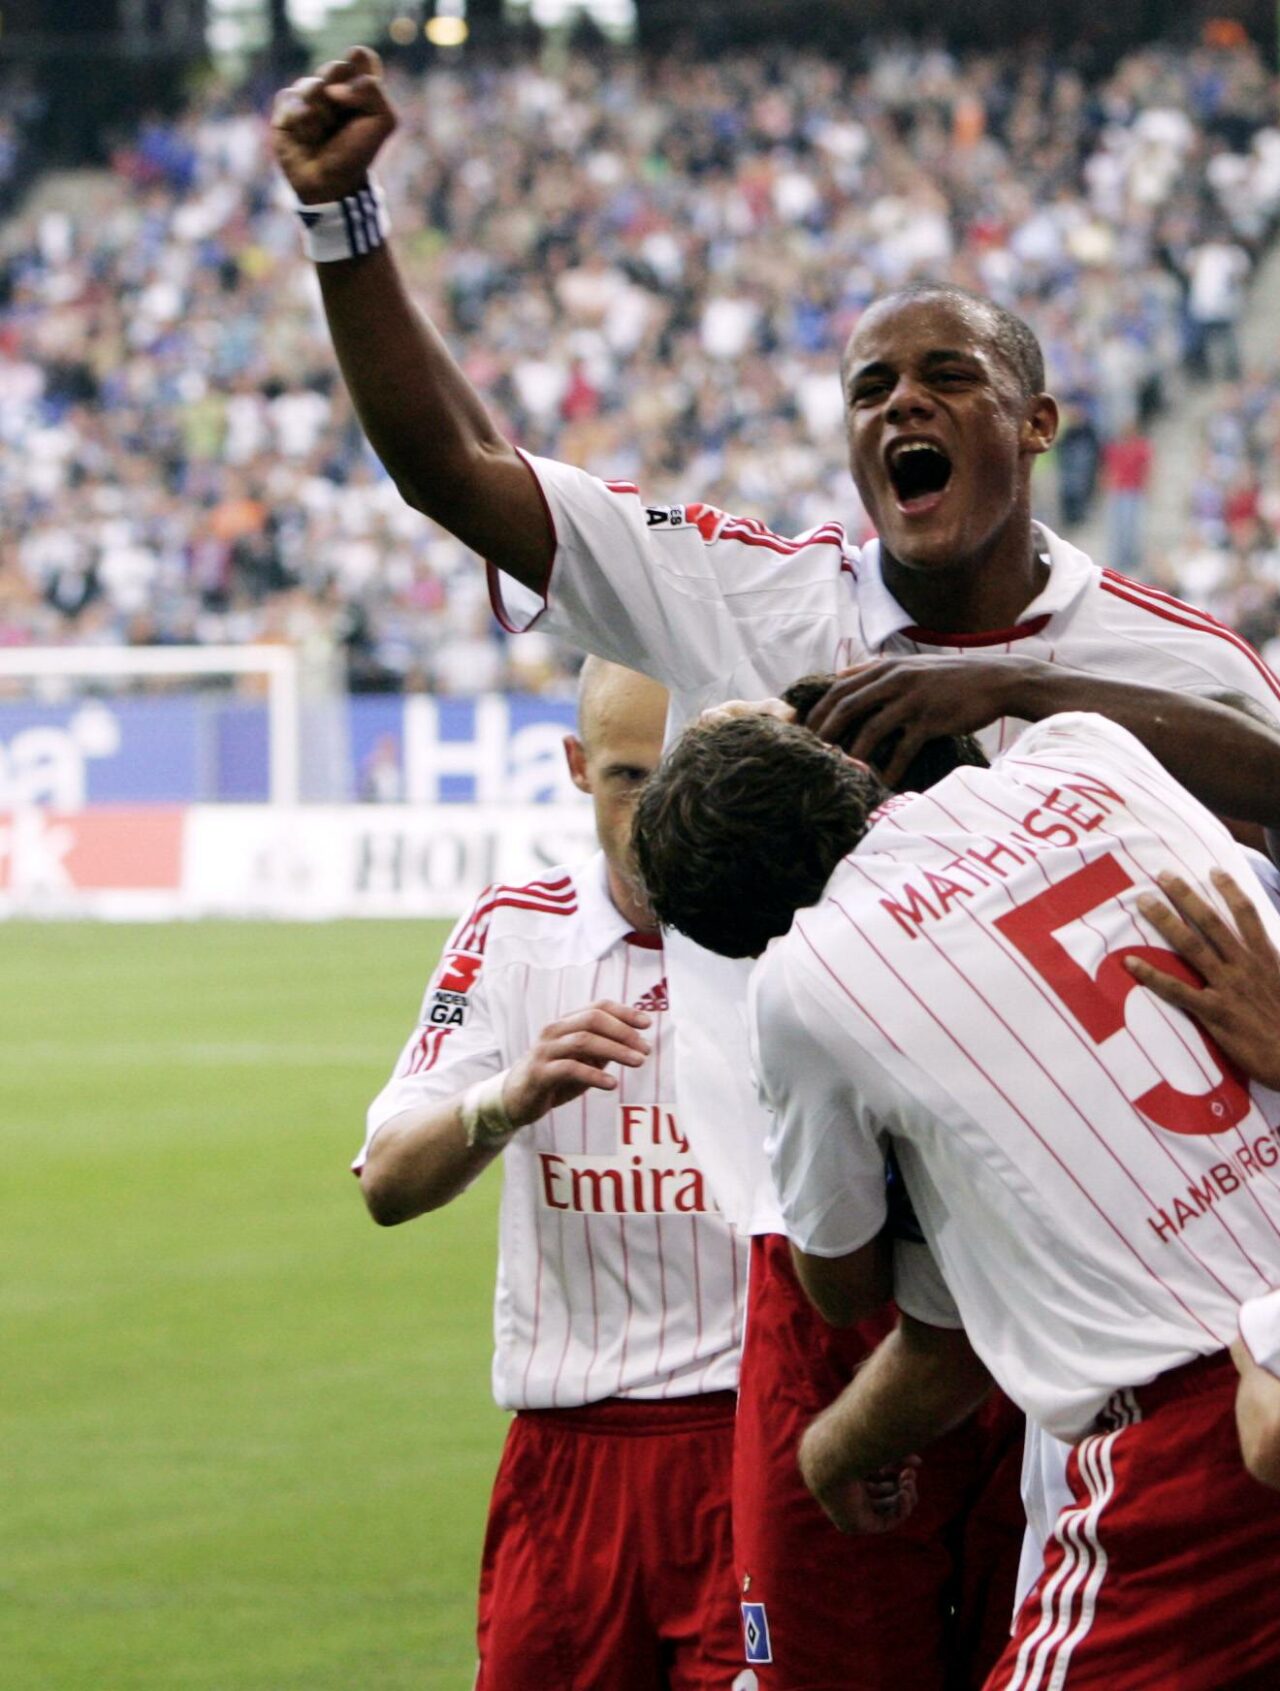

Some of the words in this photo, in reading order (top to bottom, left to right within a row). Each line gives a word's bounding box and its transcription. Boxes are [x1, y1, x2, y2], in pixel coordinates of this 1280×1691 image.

[431, 1004, 464, 1026] GA
[992, 852, 1250, 1136] 5
[620, 1106, 690, 1153] Fly
[539, 1153, 707, 1213] Emira
